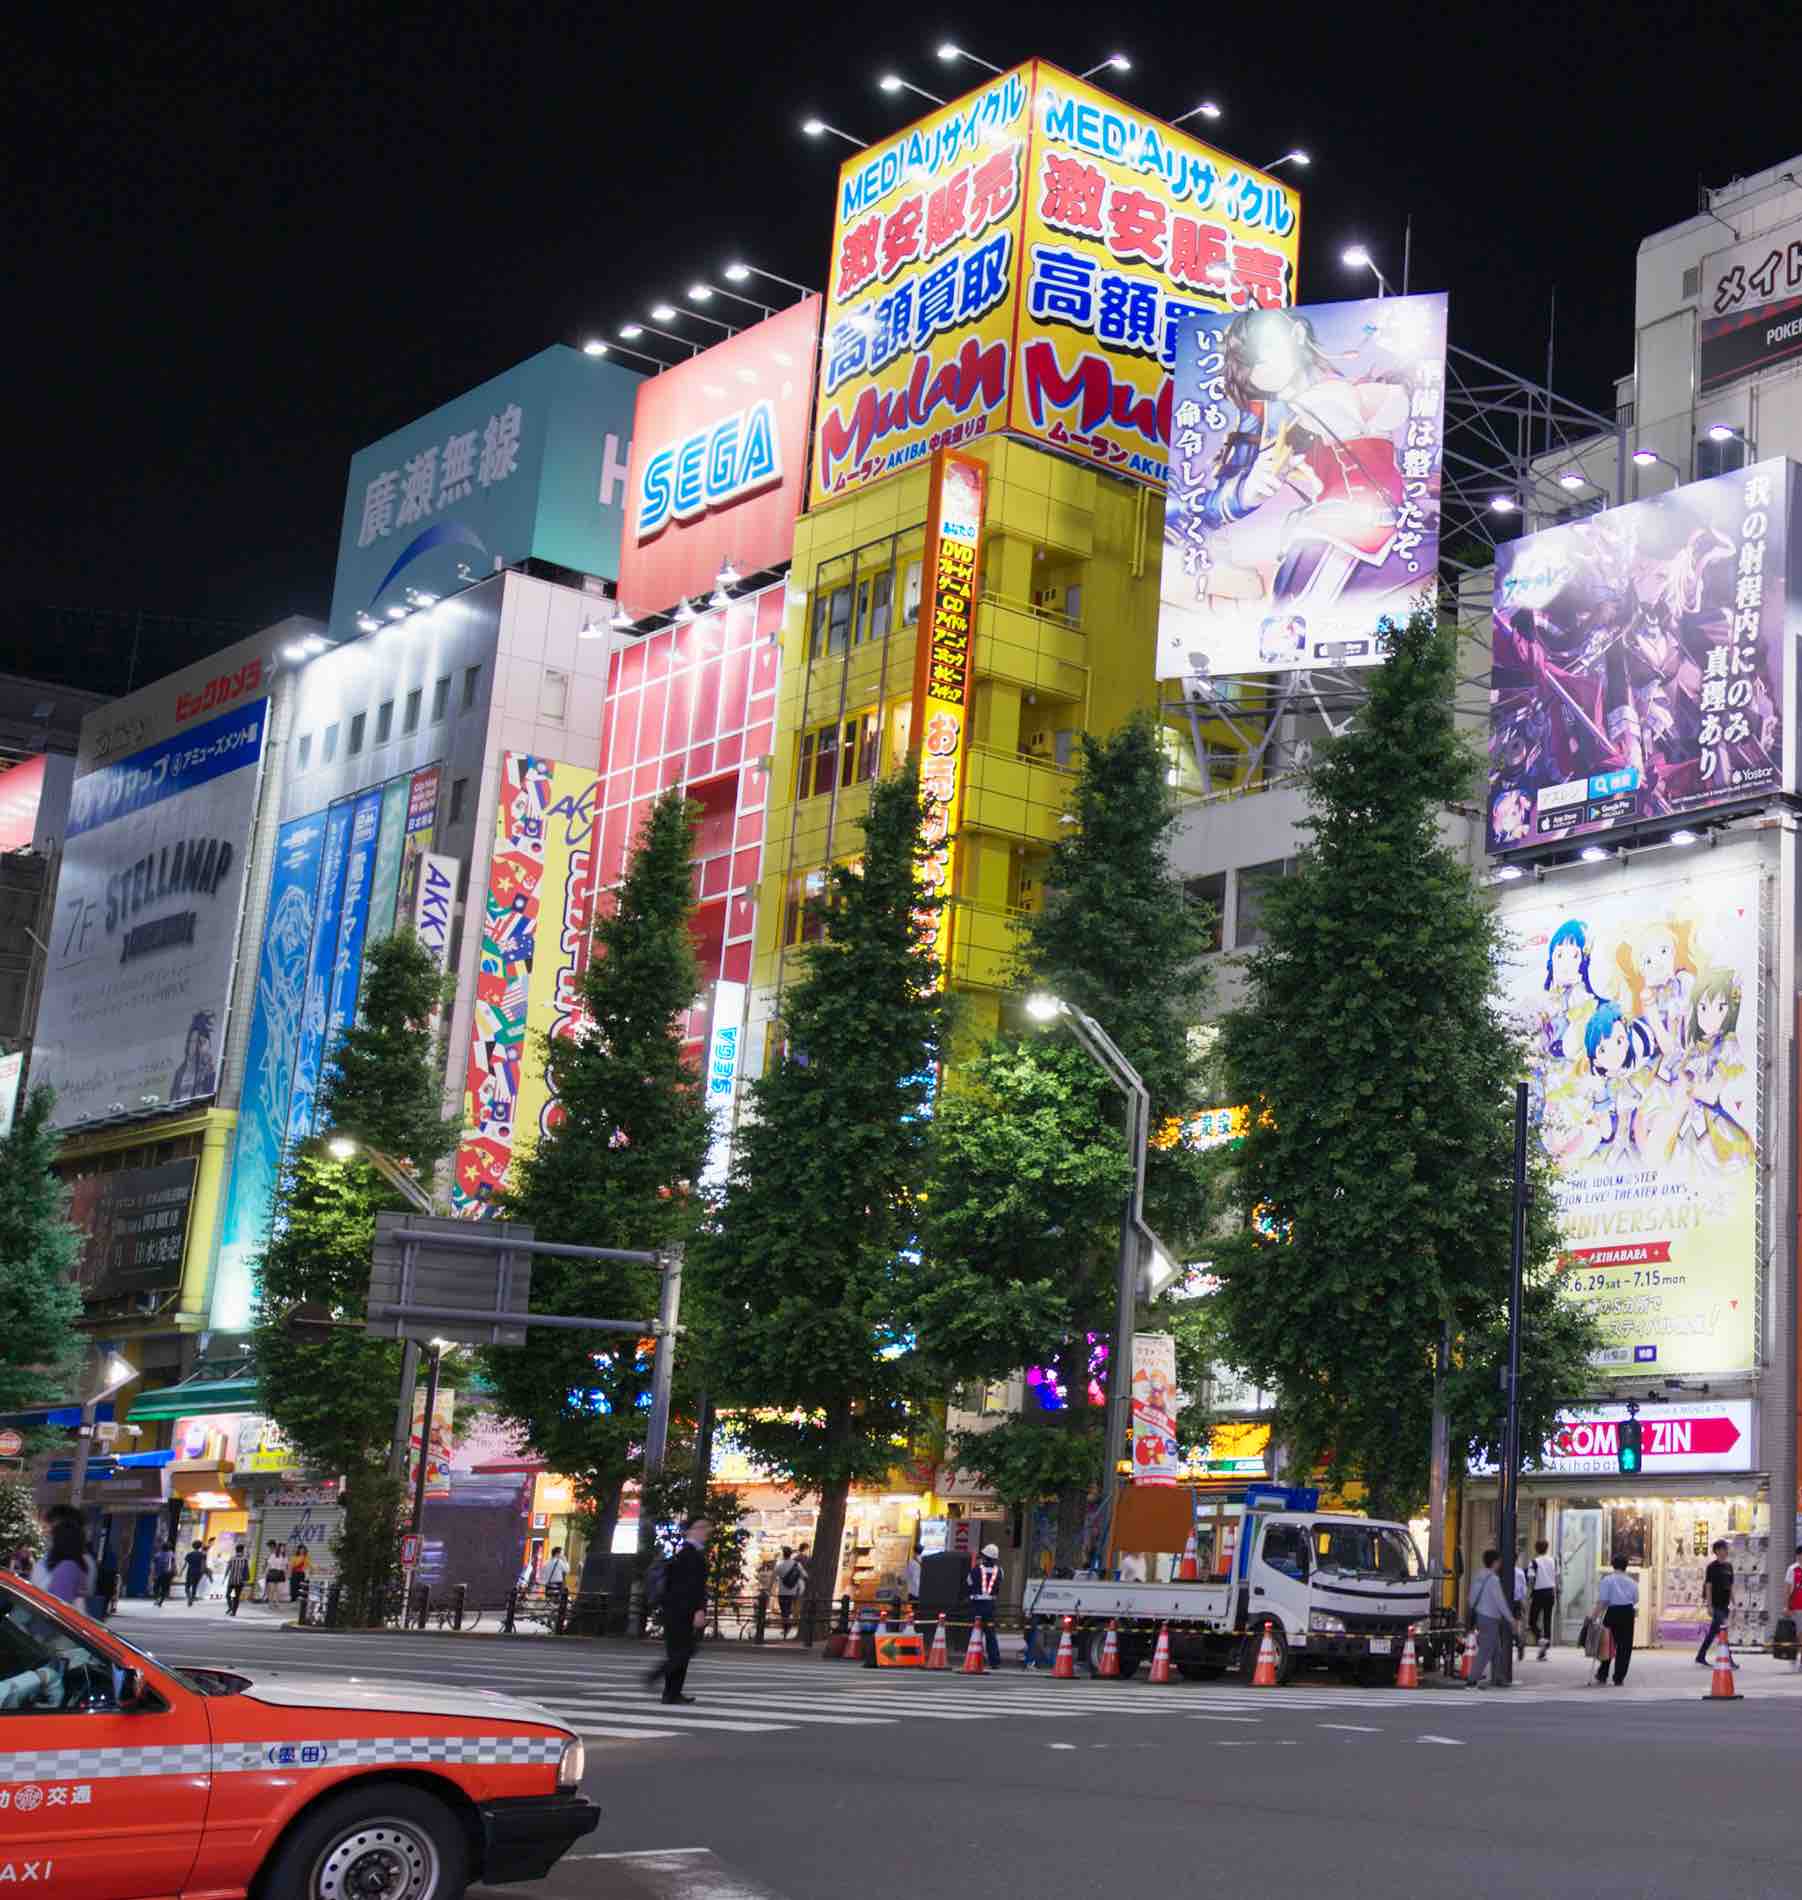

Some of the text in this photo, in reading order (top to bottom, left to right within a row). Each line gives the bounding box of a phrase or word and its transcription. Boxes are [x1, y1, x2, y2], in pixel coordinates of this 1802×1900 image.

[844, 74, 1025, 221] MEDIAリサイクル
[839, 146, 1016, 295] 激安販売
[1041, 155, 1284, 310] 激安販売
[827, 235, 1008, 388] 高額買取
[1197, 328, 1228, 431] いつでも
[1048, 421, 1128, 462] ムーラン
[637, 402, 784, 538] SEGA
[834, 455, 885, 491] ムーラン
[886, 439, 927, 469] AKIBA
[942, 541, 973, 562] DVD
[938, 575, 971, 598] ゲーム
[942, 594, 965, 613] CD
[935, 610, 967, 631] アイドル
[1723, 475, 1771, 744] 我の射程内にのみ
[933, 627, 967, 650] アニメ
[933, 666, 963, 683] ホビー
[1698, 646, 1730, 782] 真理あり
[1743, 765, 1774, 783] Yostar
[63, 898, 97, 958] 7F
[710, 1026, 738, 1095] SEGA
[1592, 1171, 1658, 1189] IDOLMSTER
[1633, 1270, 1661, 1288] 7.15
[1651, 1421, 1692, 1453] ZIN
[46, 1785, 92, 1807] 交通
